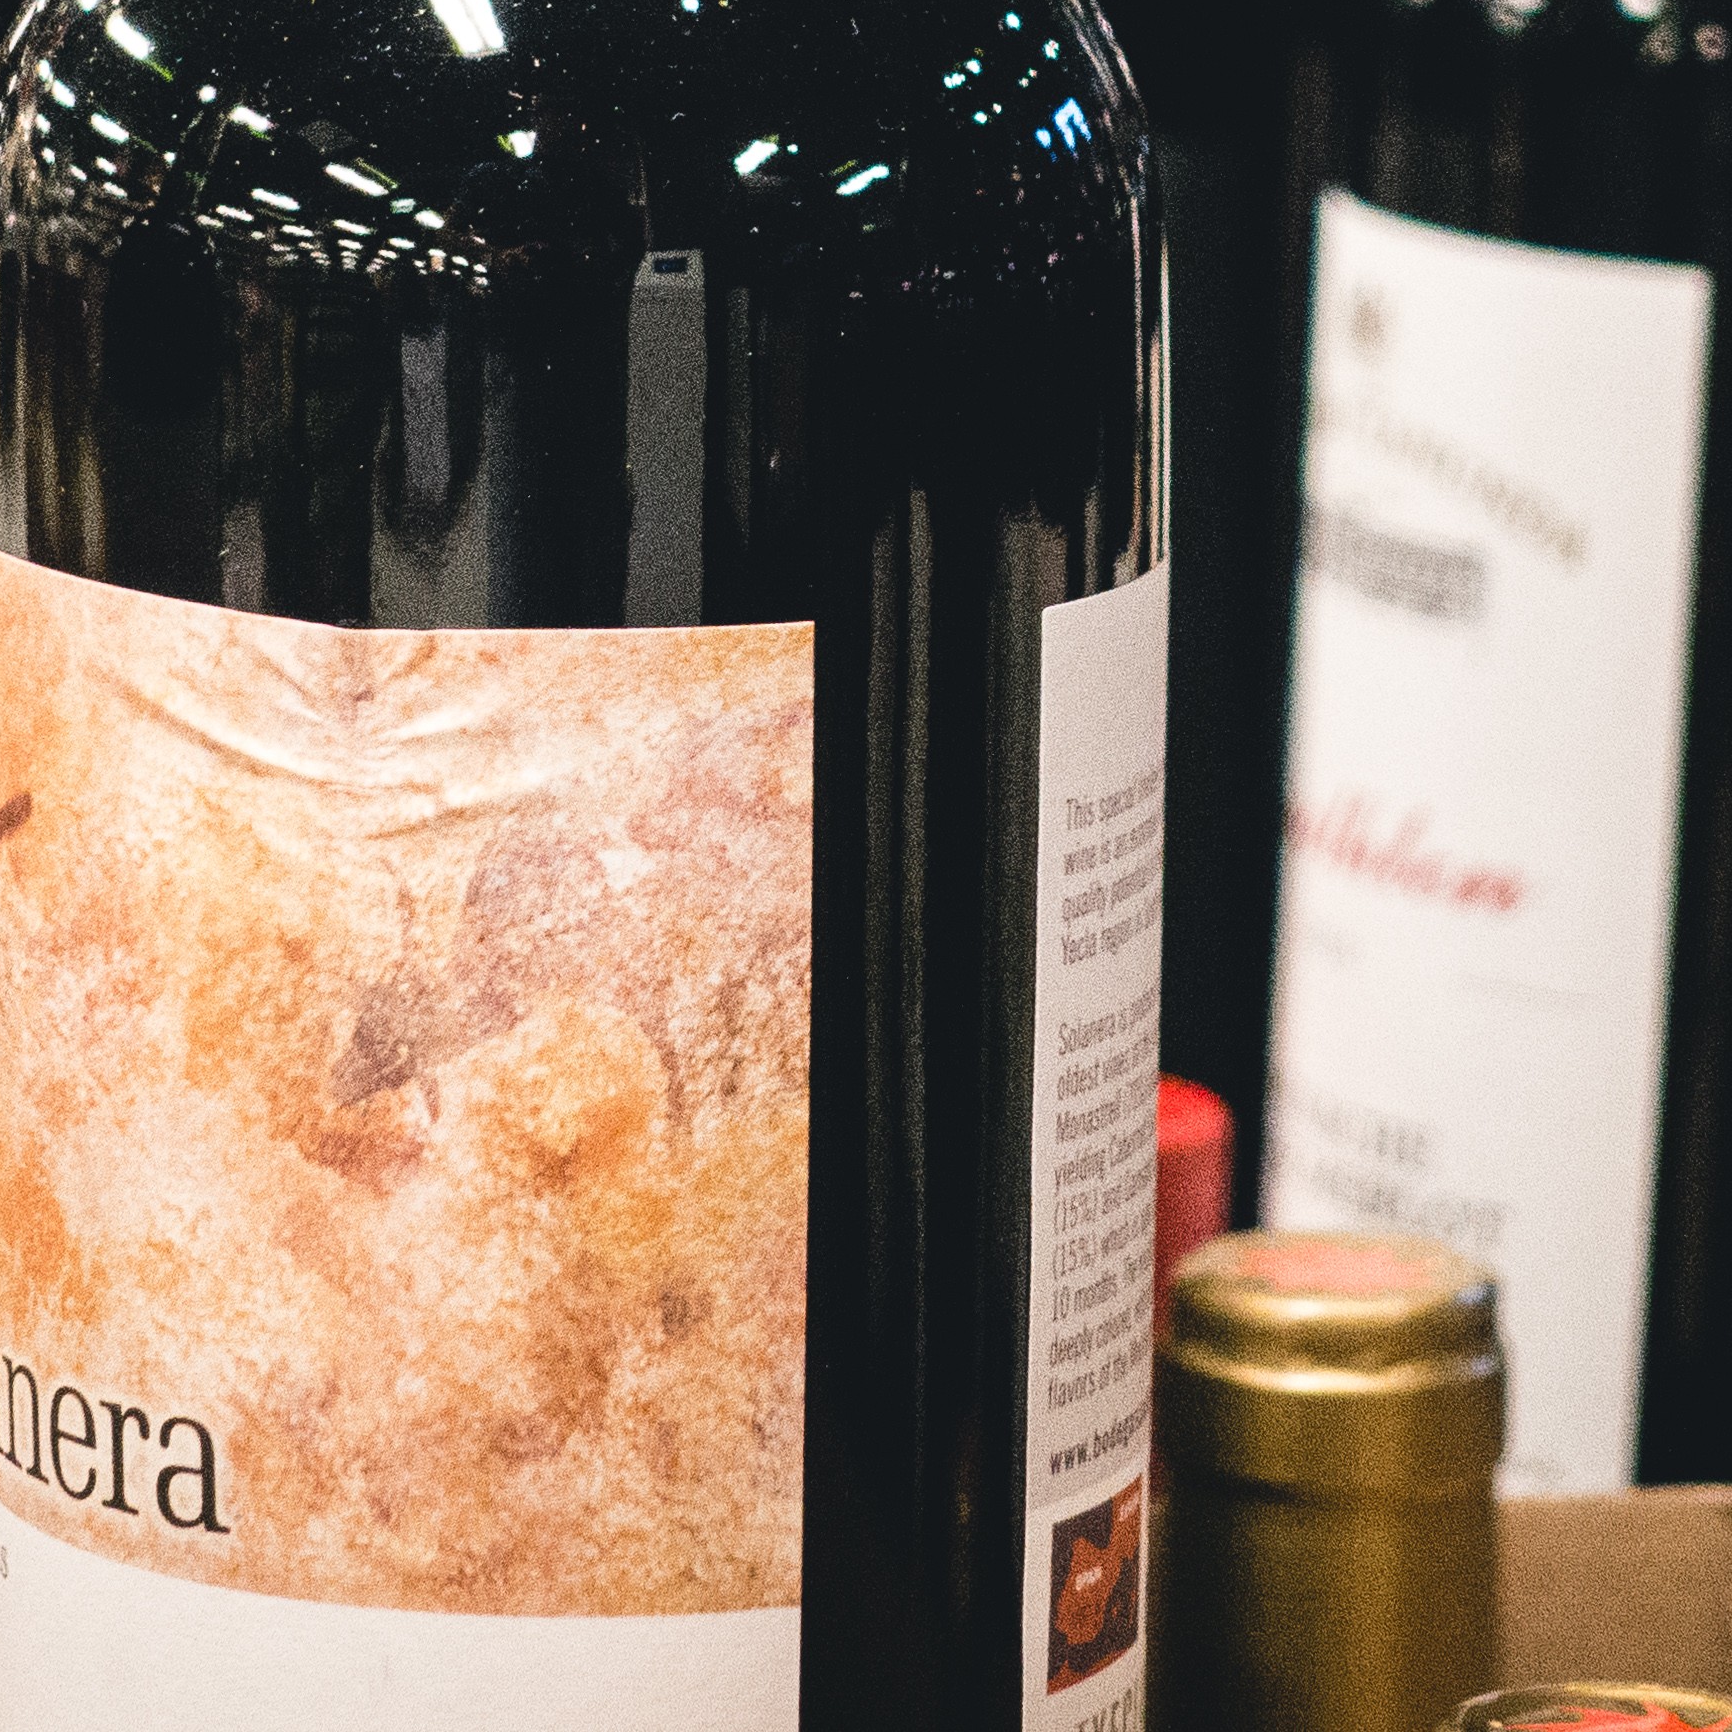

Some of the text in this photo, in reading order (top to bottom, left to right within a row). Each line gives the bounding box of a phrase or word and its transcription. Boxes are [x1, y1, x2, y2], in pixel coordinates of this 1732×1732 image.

[1066, 796, 1095, 833] This
[1061, 926, 1097, 966] Yecla
[1058, 1011, 1116, 1056] Solanera
[1057, 1059, 1100, 1101] oldest
[1053, 1188, 1099, 1236] (15%)
[1051, 1231, 1097, 1282] (15%)
[1051, 1286, 1071, 1323] 10
[1047, 1373, 1097, 1413] flavors
